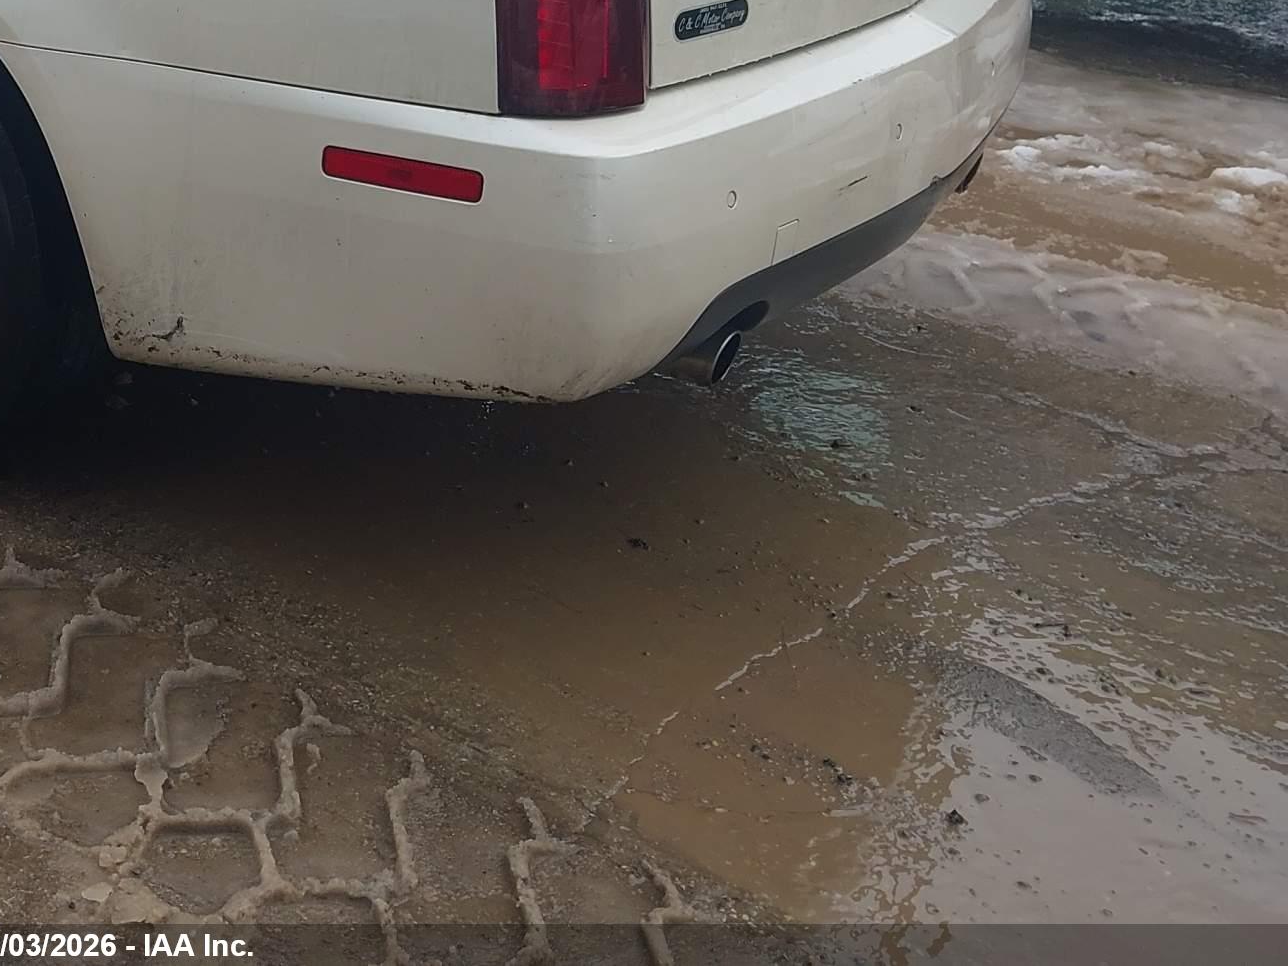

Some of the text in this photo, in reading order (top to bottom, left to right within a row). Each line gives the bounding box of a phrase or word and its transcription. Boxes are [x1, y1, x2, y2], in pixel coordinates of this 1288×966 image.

[686, 18, 693, 30] &
[702, 12, 720, 27] Motor
[721, 8, 745, 22] Company
